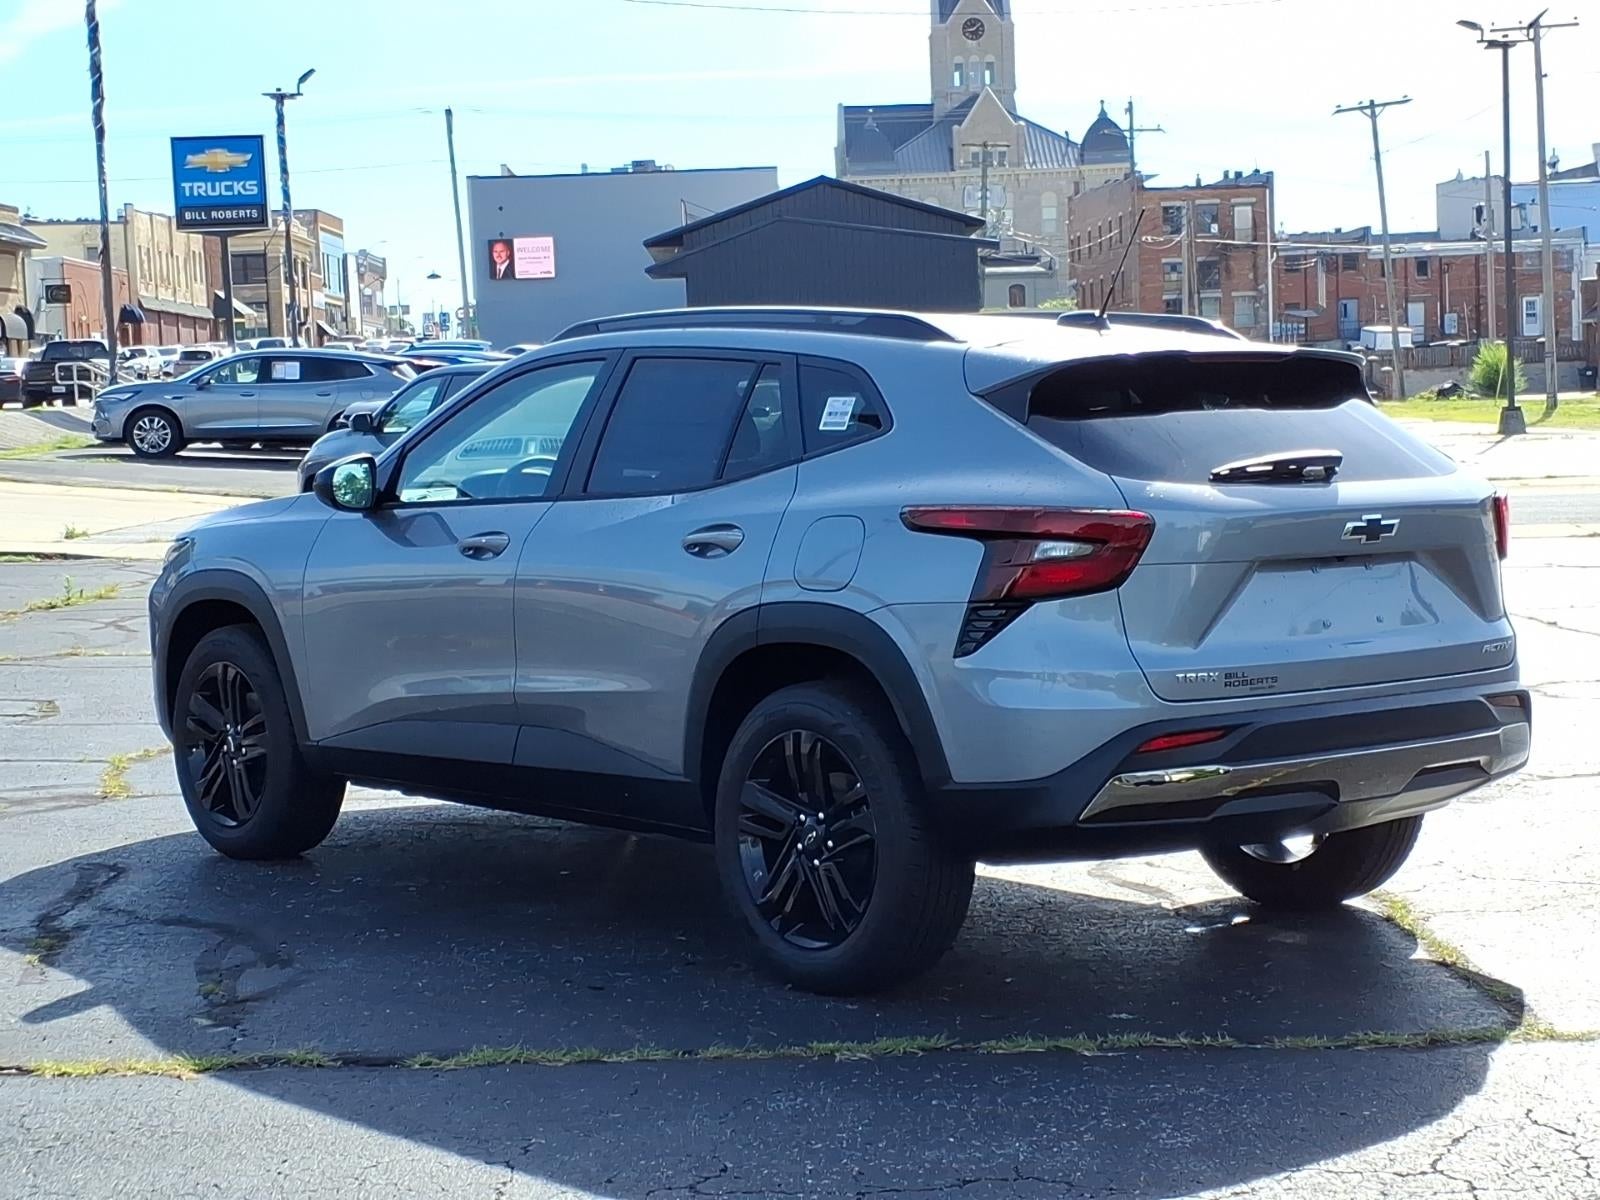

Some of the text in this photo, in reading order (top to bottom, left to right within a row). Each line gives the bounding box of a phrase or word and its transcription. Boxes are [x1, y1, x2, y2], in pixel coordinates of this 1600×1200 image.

[181, 181, 258, 197] TRUCKS
[184, 209, 258, 220] BILL ROBERTS
[1175, 671, 1219, 683] TRAX
[1224, 672, 1248, 680] BILL
[1224, 676, 1278, 688] ROBERTS
